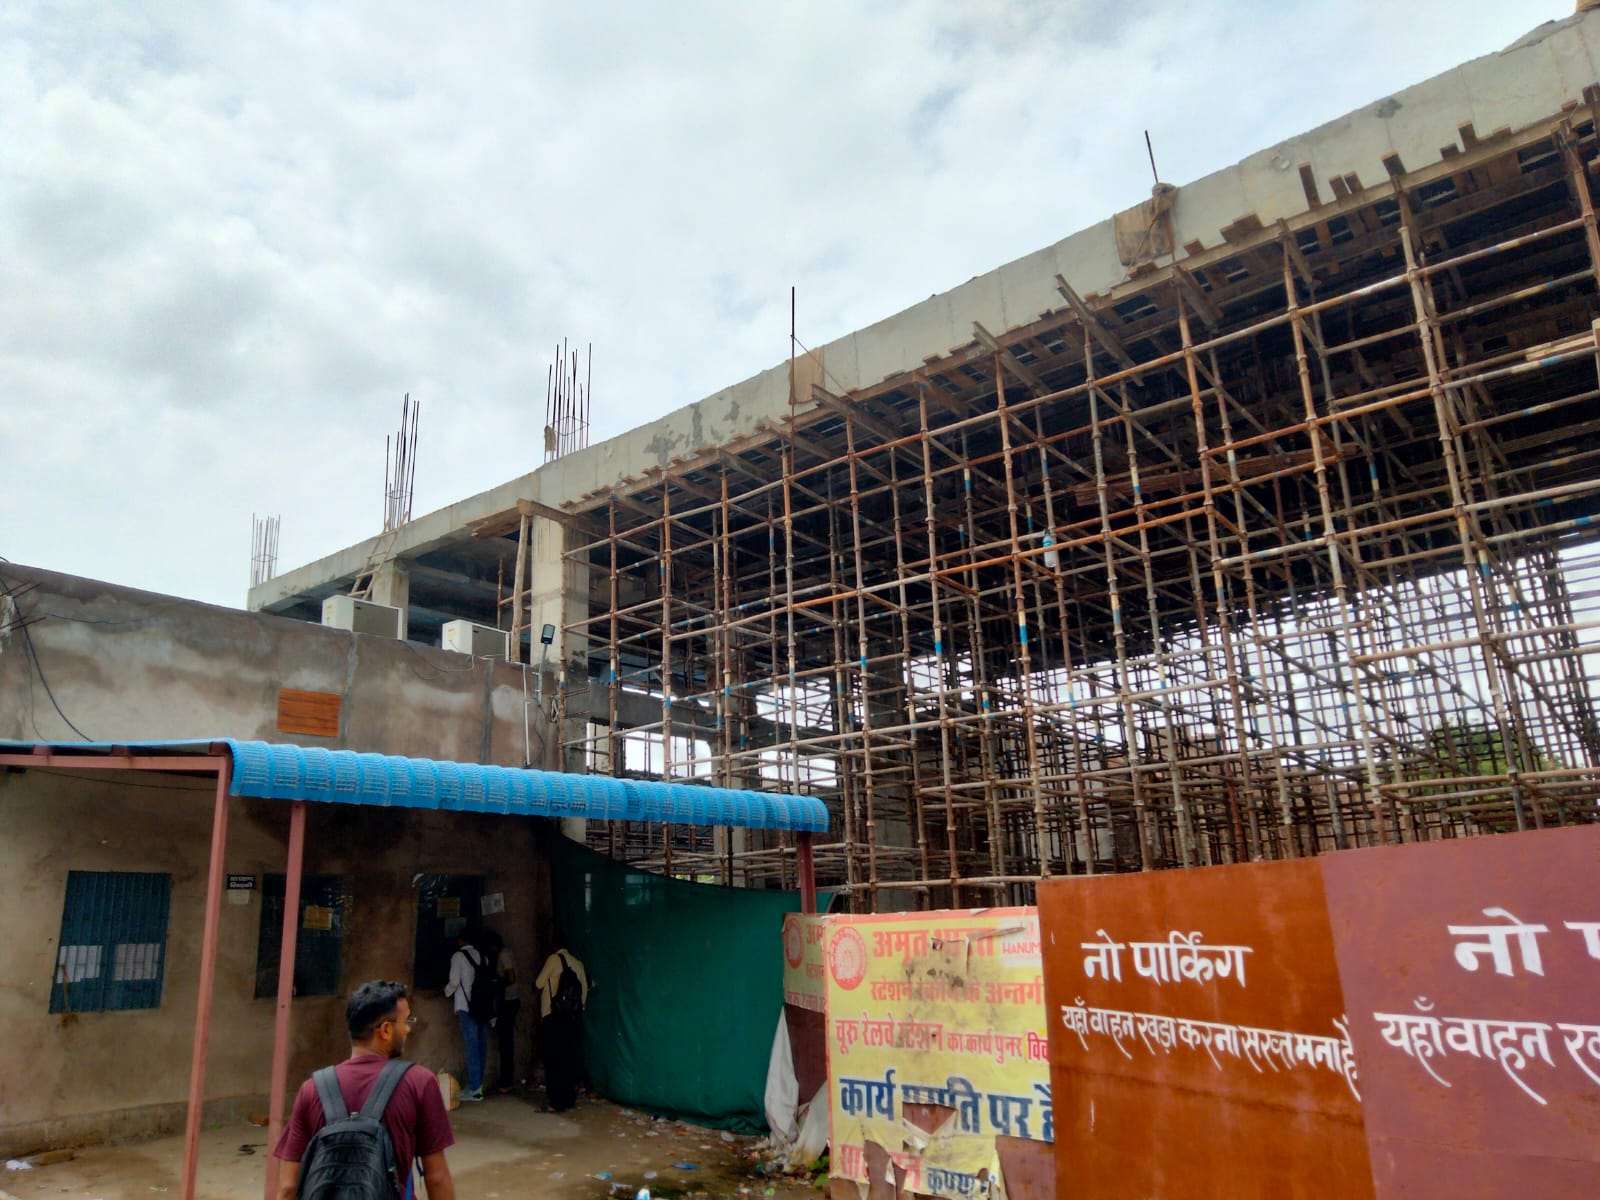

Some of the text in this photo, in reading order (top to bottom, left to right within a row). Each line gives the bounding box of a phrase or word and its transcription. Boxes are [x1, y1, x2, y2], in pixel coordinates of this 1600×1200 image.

[872, 927, 930, 967] अमृत
[1081, 929, 1254, 988] नो पार्किंग
[1448, 907, 1550, 977] नो
[862, 1011, 894, 1048] रेलवे
[947, 1033, 963, 1053] का
[966, 1028, 992, 1055] कार्य
[1088, 1007, 1133, 1060] वाहन
[1176, 1018, 1241, 1071] करना
[1293, 1033, 1344, 1075] मना
[1373, 996, 1452, 1088] यहाँ
[1442, 1017, 1556, 1105] वाहन
[839, 1069, 896, 1121] कार्य
[987, 1094, 1033, 1138] पर
